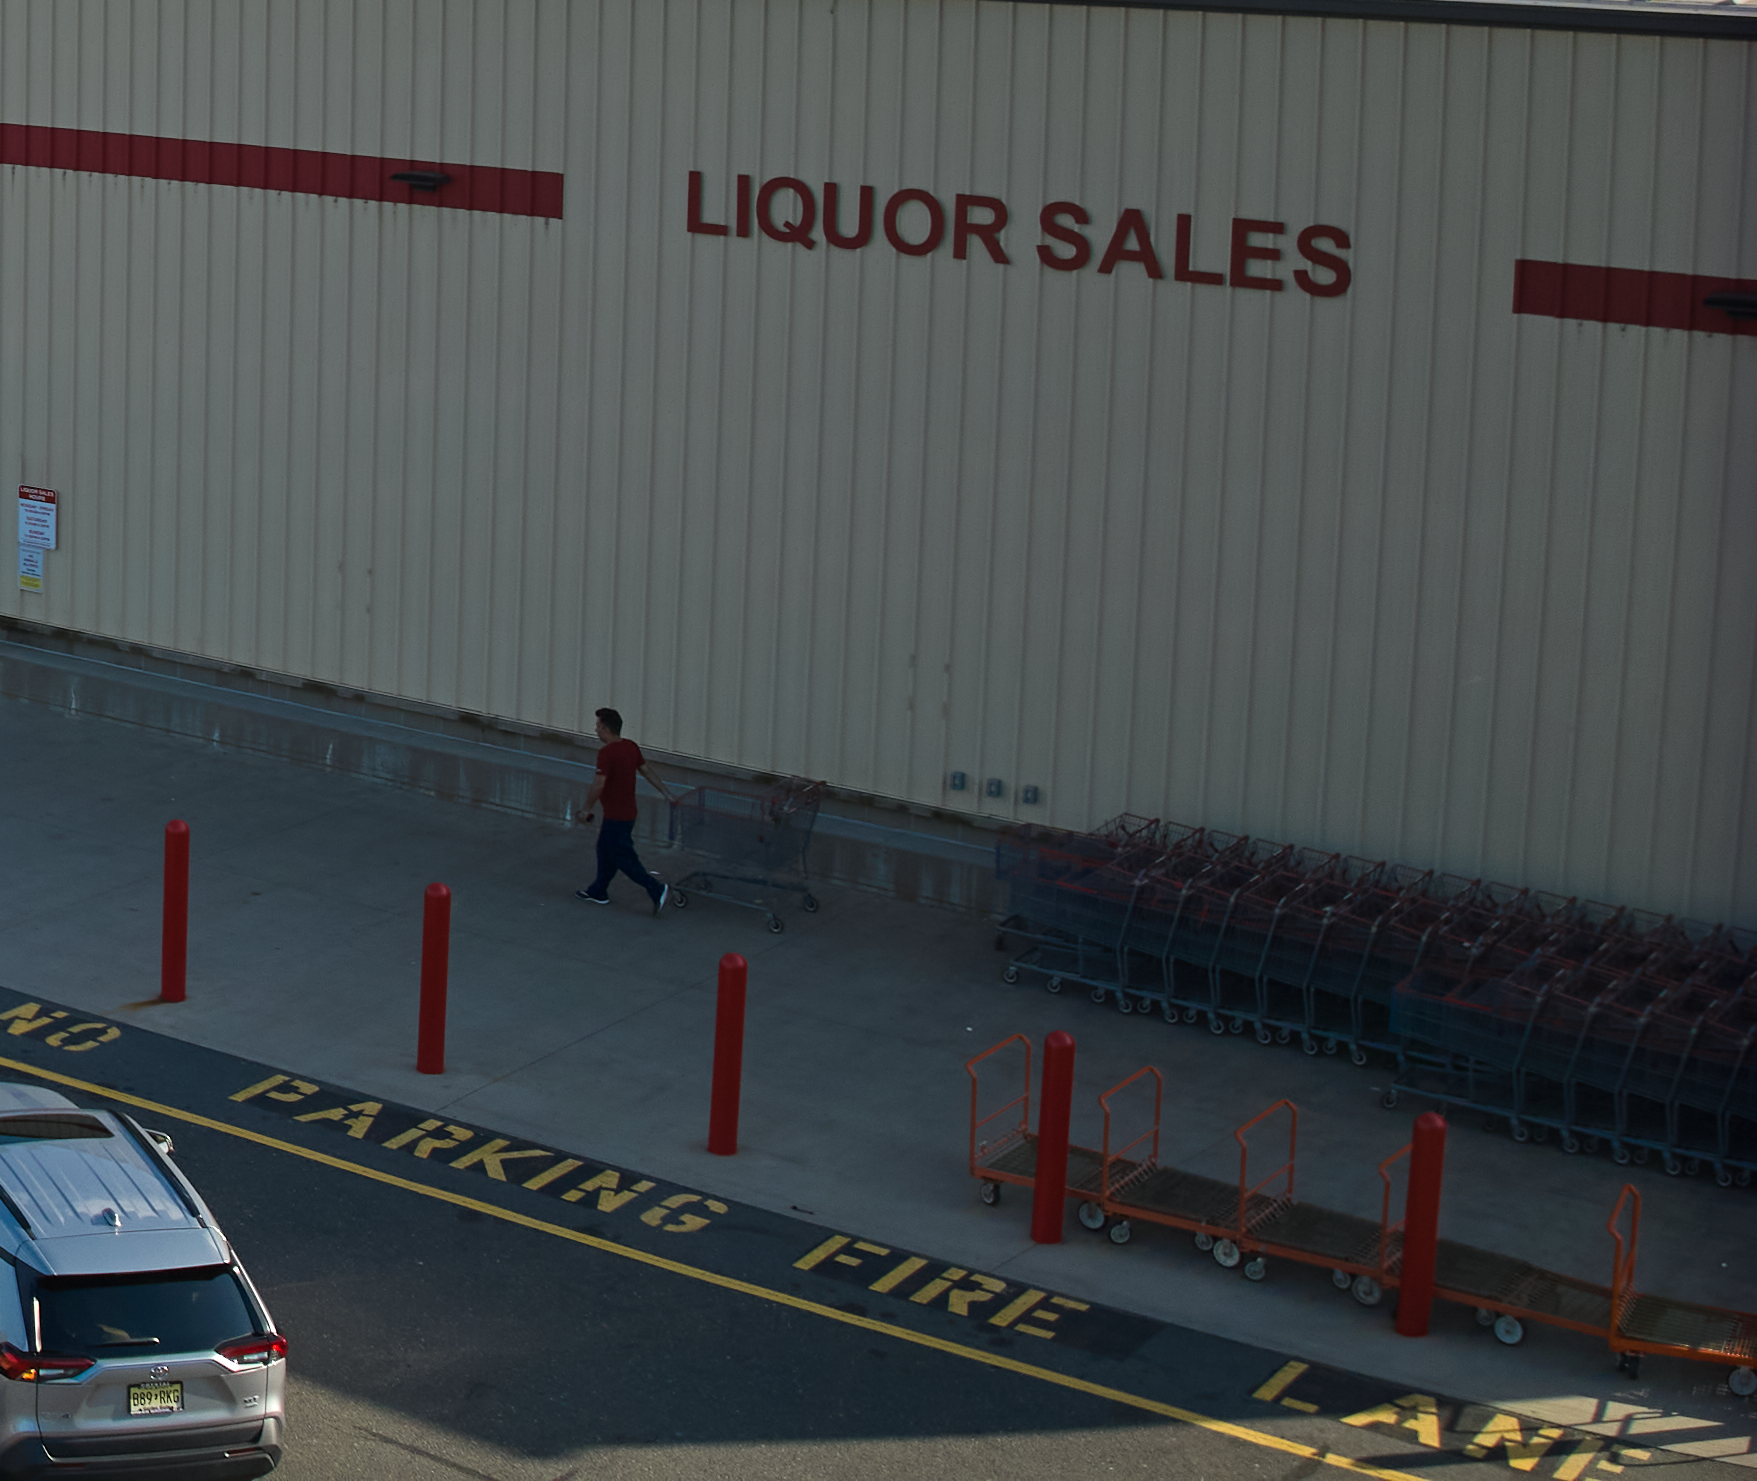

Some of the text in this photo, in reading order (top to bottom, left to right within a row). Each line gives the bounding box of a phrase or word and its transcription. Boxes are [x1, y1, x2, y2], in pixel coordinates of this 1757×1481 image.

[686, 170, 1353, 298] LIQUOR SALES
[227, 1073, 729, 1234] PARKING
[792, 1234, 1091, 1339] FIRE
[1252, 1360, 1653, 1481] LANE
